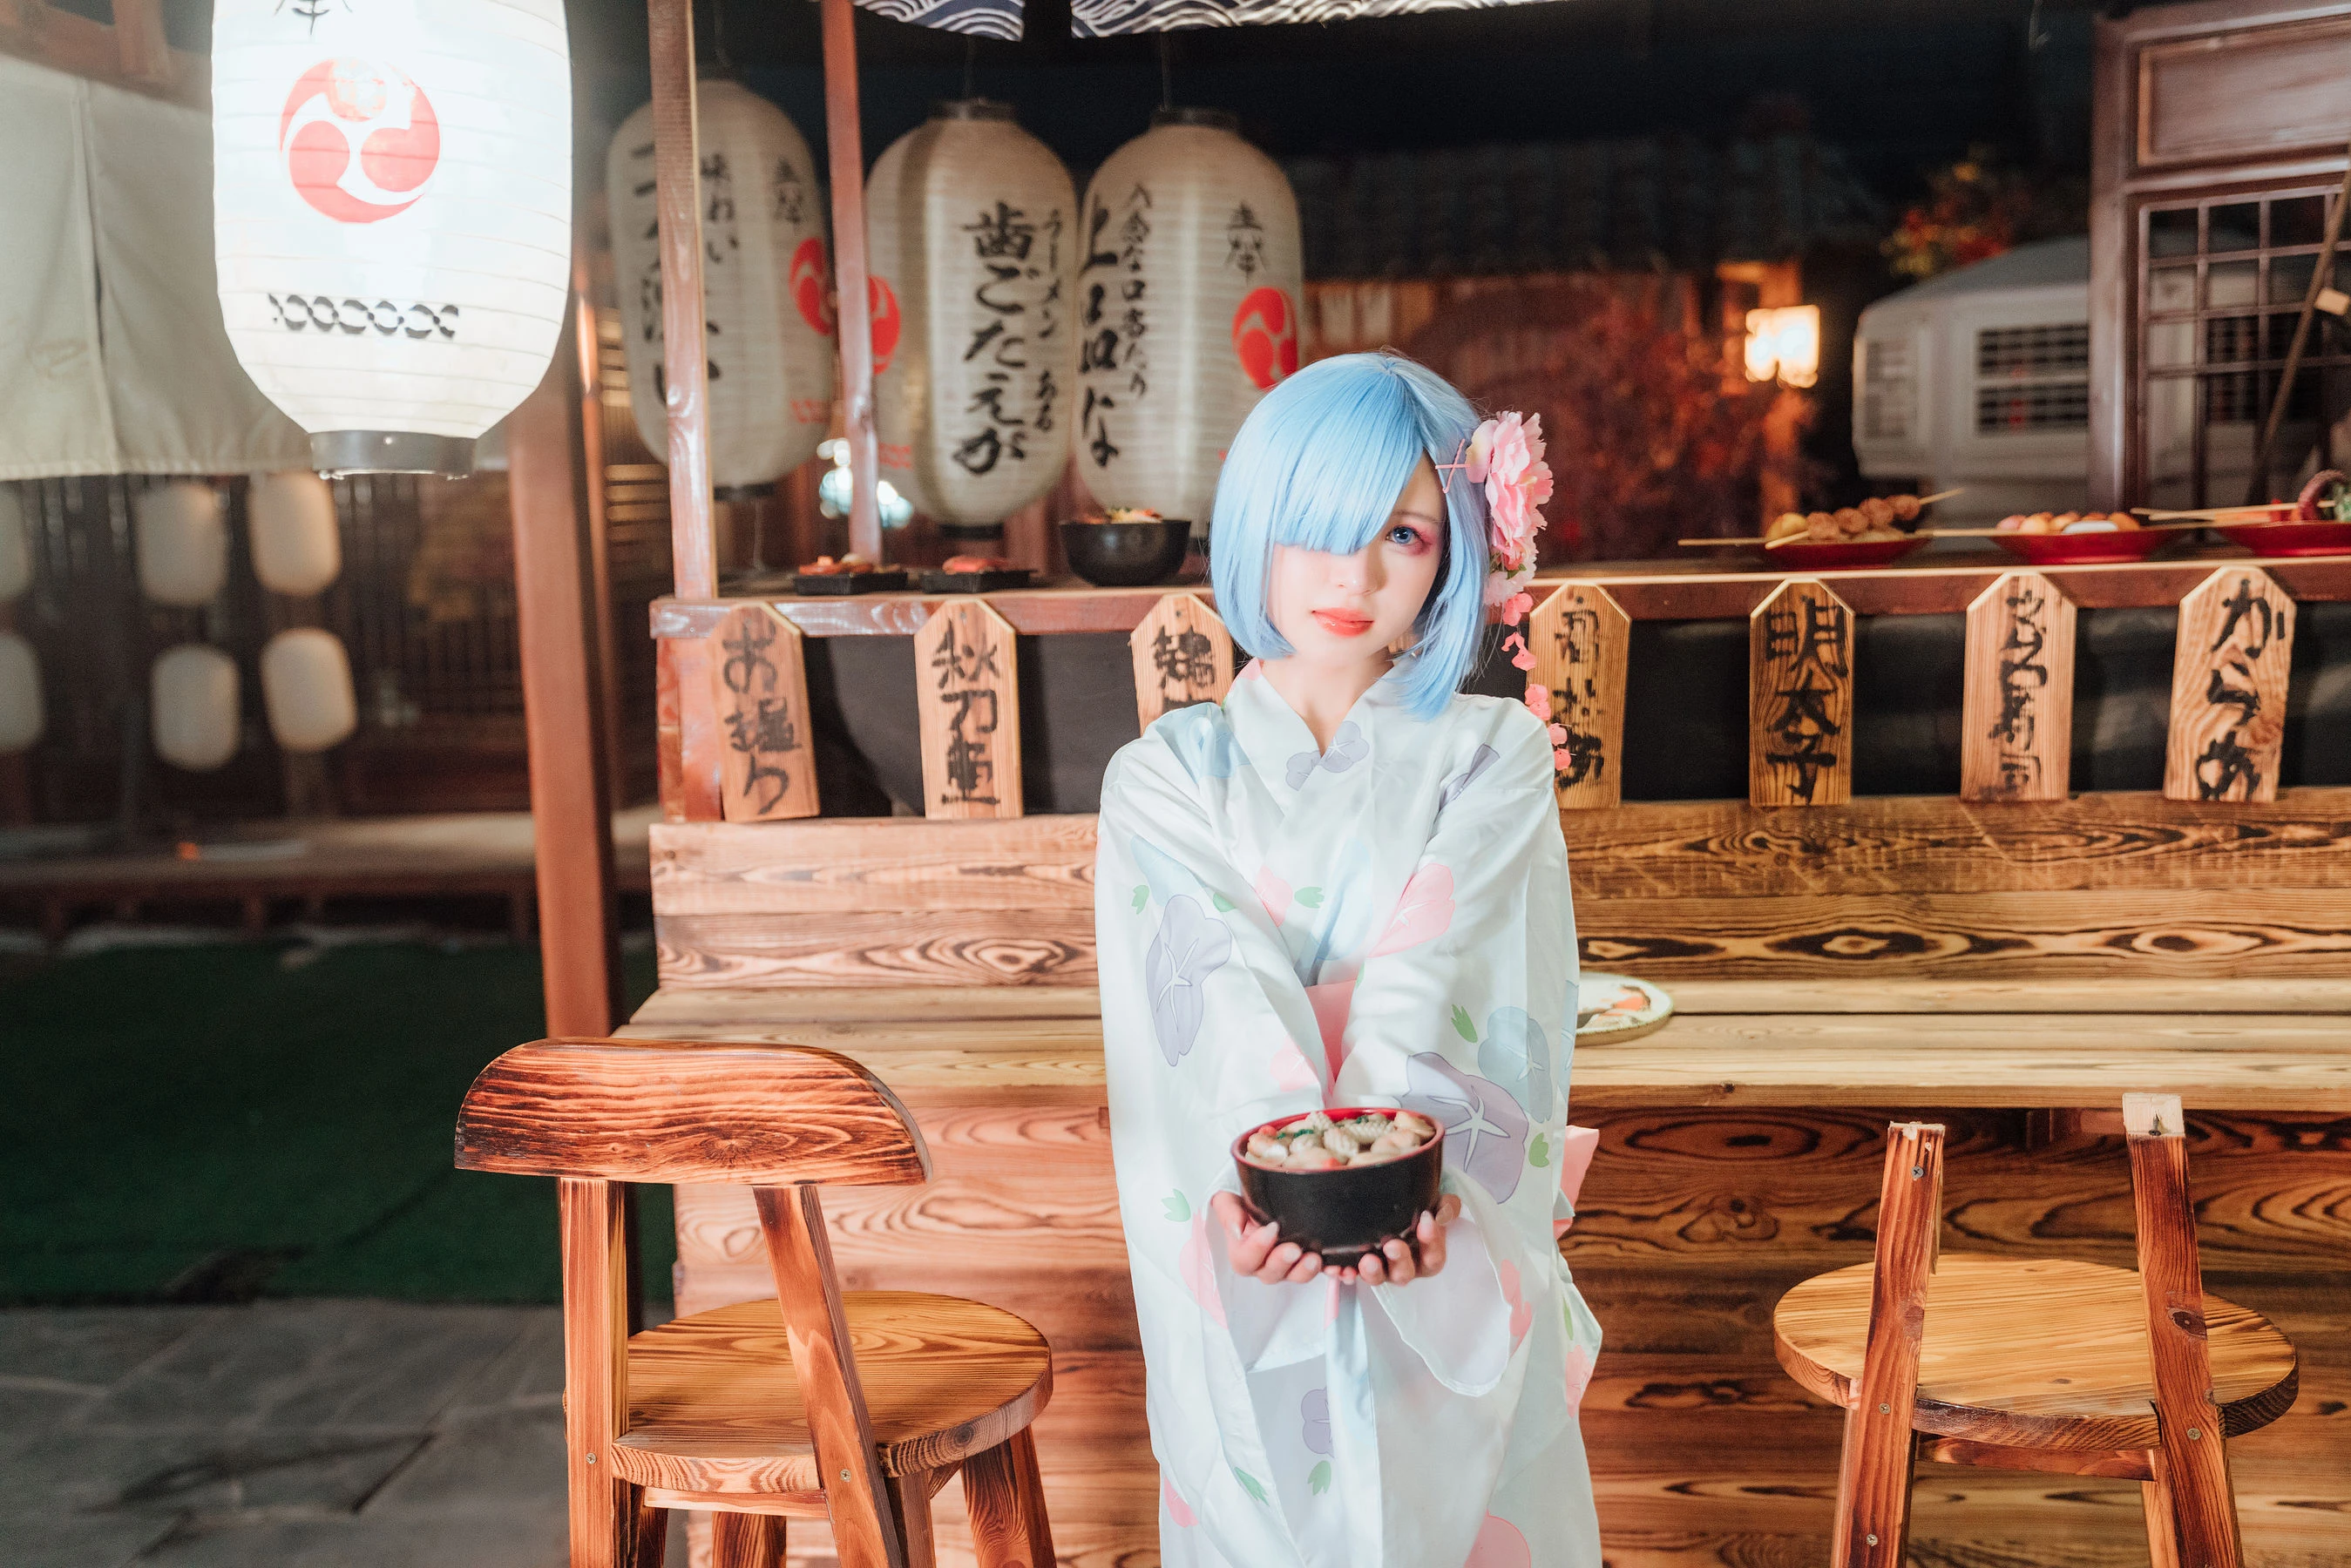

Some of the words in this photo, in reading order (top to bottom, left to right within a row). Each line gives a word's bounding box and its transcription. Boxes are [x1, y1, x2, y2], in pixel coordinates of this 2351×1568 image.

[931, 618, 1000, 805] 秋刀魚
[1765, 596, 1848, 806] 明太子
